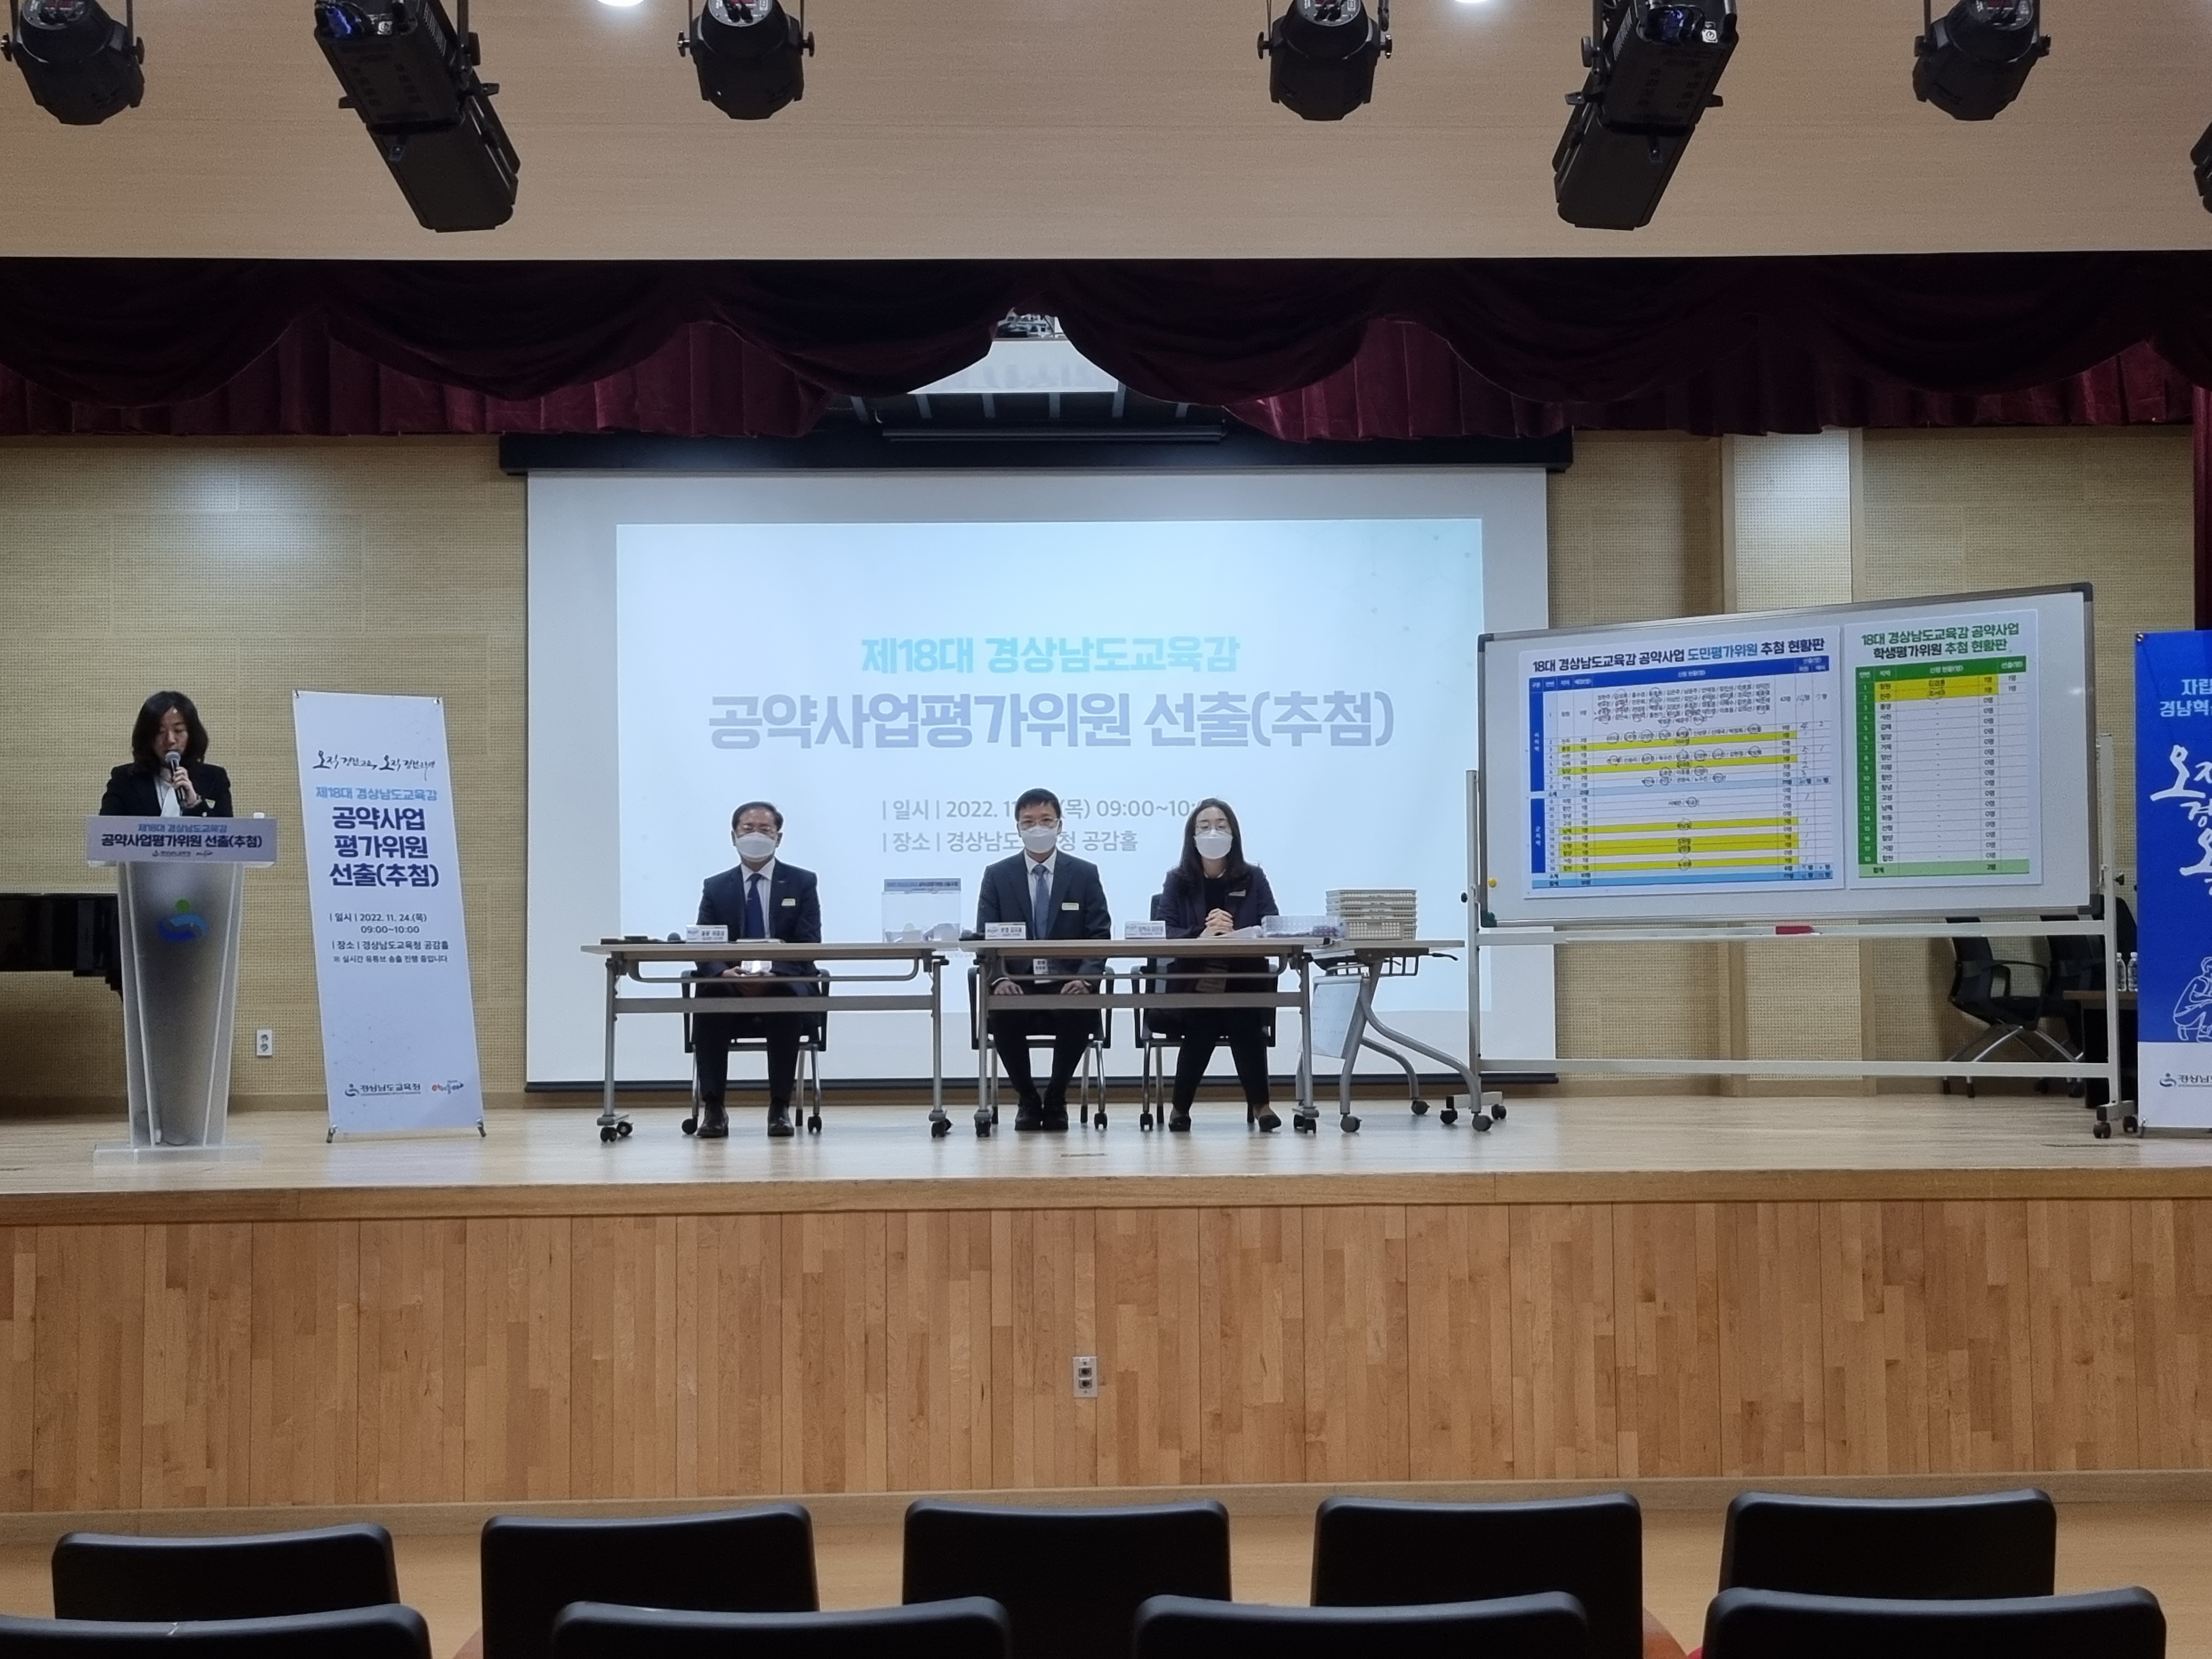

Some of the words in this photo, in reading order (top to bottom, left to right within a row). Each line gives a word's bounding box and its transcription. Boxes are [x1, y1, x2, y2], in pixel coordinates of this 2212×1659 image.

[1861, 633, 1885, 646] 18대
[1888, 627, 1970, 645] 경상남도교육감
[1971, 623, 2019, 637] 공약사업
[862, 636, 973, 674] 제18대
[985, 635, 1240, 673] 경상남도교육감
[1532, 659, 1555, 673] 18대
[1559, 652, 1637, 672] 경상남도교육감
[1639, 648, 1685, 665] 공약사업
[1688, 643, 1758, 661] 도민평가위원
[1760, 641, 1785, 656] 추첨
[1787, 637, 1825, 653] 현황판
[1874, 643, 1942, 660] 학생평가위원
[1945, 641, 1968, 655] 추첨
[1971, 638, 2007, 653] 현황판
[709, 692, 1131, 749] 공약사업평가위원
[1143, 690, 1394, 747] 선출(추첨)
[2160, 699, 2212, 718] 경남혁
[315, 786, 353, 799] 제18대
[356, 788, 437, 801] 경상남도교육감
[332, 806, 425, 831] 공약사업
[893, 799, 929, 820] 일시
[946, 800, 998, 817] 2022.
[101, 833, 202, 848] 공약사업평가위원
[206, 835, 262, 848] 선출(추첨)
[334, 835, 428, 859] 평가위원
[893, 831, 930, 852] 장소
[1082, 830, 1138, 851] 공감홀
[329, 863, 439, 887] 선출(추첨)
[335, 912, 352, 922] 일시
[359, 913, 384, 922] 2022.
[360, 926, 420, 934] 09:00~10:00
[337, 940, 355, 950] 장소
[362, 940, 421, 950] 경상남도교육청
[424, 940, 449, 950] 공감홀
